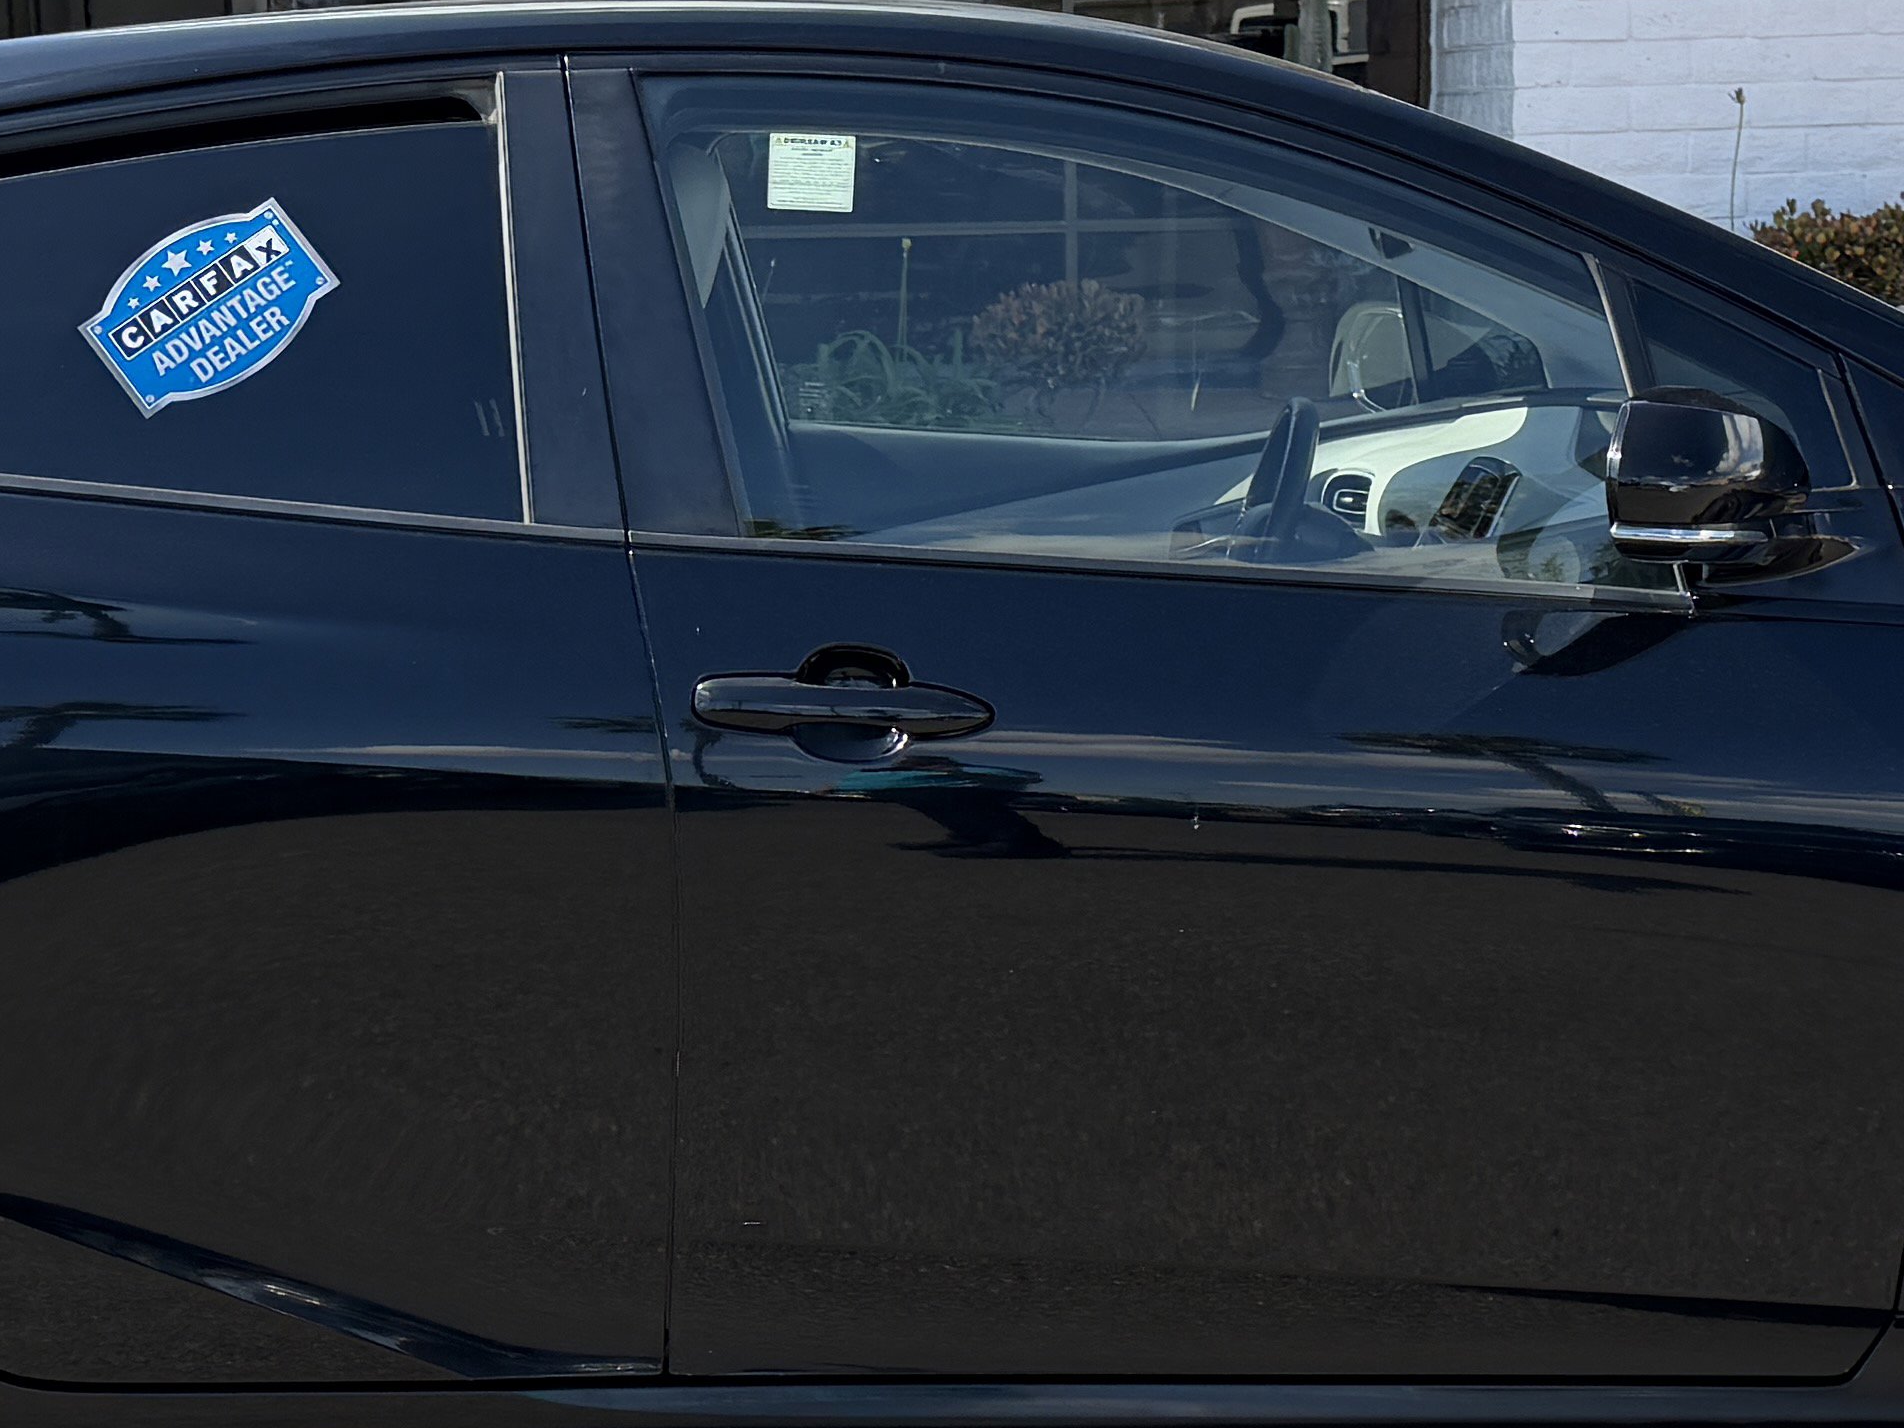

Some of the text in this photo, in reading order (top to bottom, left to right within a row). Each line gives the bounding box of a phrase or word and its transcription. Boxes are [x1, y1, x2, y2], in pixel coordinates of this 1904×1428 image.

[120, 235, 282, 350] CARFAX
[151, 268, 297, 376] ADVANTAGE
[189, 306, 291, 383] DEALER
